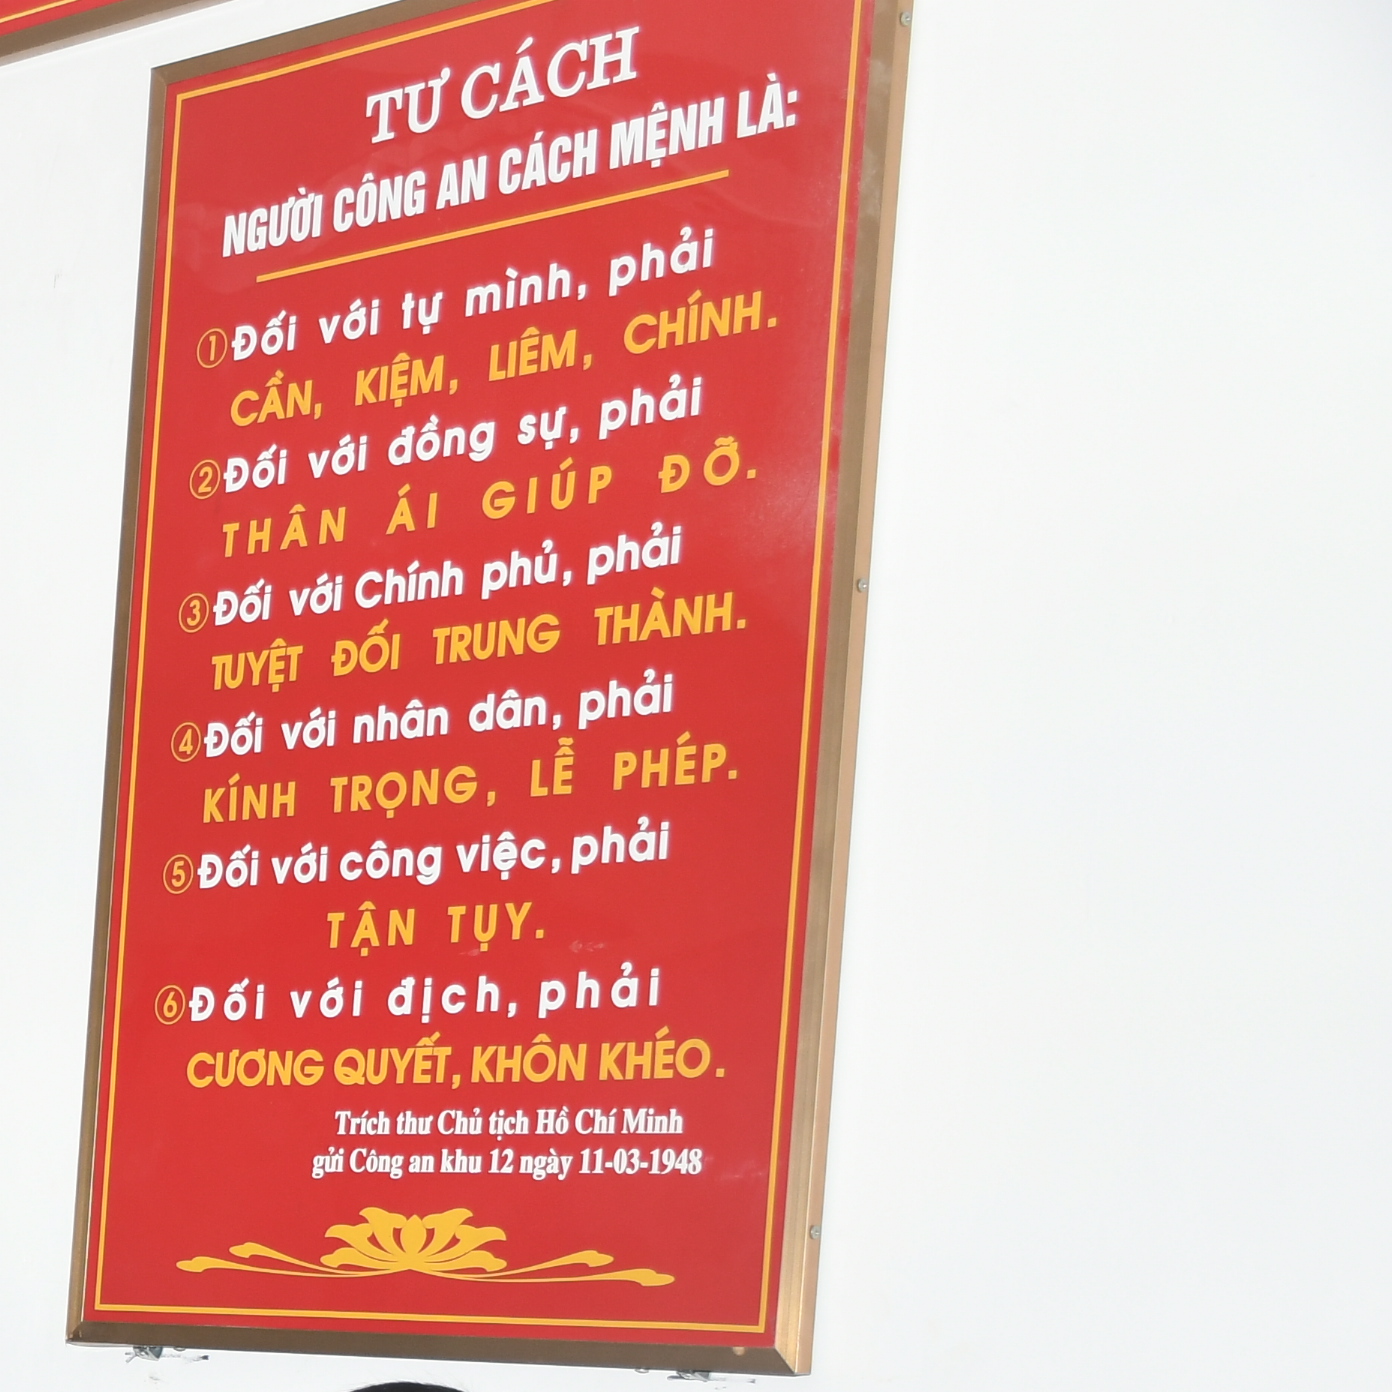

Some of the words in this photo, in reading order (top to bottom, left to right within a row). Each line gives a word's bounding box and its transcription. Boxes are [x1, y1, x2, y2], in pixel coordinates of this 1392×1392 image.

[365, 66, 452, 144] TƯ
[460, 25, 641, 120] CÁCH
[222, 186, 324, 258] NGƯỜI
[333, 169, 427, 233] CÔNG
[435, 154, 488, 210] AN
[498, 128, 598, 195] CÁCH
[609, 96, 725, 170] MỆNH
[736, 72, 798, 139] LÀ:
[231, 309, 297, 361] Đối
[318, 298, 380, 344] với
[401, 291, 444, 335] tự
[465, 262, 587, 317] mình,
[608, 225, 714, 297] phải
[230, 369, 322, 427] CẦN,
[354, 352, 458, 408] KIỆM,
[488, 326, 592, 382] LIÊM,
[623, 289, 777, 354] CHÍNH.
[222, 443, 288, 493] Đối
[308, 433, 368, 479] với
[387, 413, 496, 466] đồng
[517, 405, 580, 450] sự,
[598, 373, 703, 441] phải
[222, 503, 346, 558] THÂN
[386, 483, 438, 535] ÁI
[482, 456, 612, 519] GIÚP
[658, 435, 756, 493] ĐỠ.
[212, 578, 273, 626] Đối
[288, 572, 344, 616] với
[354, 559, 465, 609] Chính
[481, 538, 573, 600] phủ,
[586, 521, 682, 585] phải
[211, 637, 304, 693] TUYỆT
[331, 618, 401, 677] ĐỐI
[432, 613, 561, 665] TRUNG
[594, 586, 746, 646] THÀNH.
[203, 710, 264, 758] Đối
[280, 706, 337, 750] với
[353, 698, 450, 744] nhân
[468, 688, 562, 733] dân,
[578, 667, 674, 730] phải
[203, 773, 296, 823] KÍNH
[330, 765, 496, 819] TRỌNG,
[530, 737, 575, 797] LỄ
[613, 731, 738, 791] PHÉP.
[196, 843, 260, 889] Đối
[271, 841, 329, 885] với
[339, 839, 443, 886] công
[455, 830, 561, 881] việc,
[571, 815, 670, 875] phải
[326, 900, 416, 957] TẬN
[447, 901, 544, 952] TỤY.
[188, 977, 265, 1022] Đối
[289, 976, 364, 1018] với
[387, 974, 518, 1024] địch,
[538, 961, 660, 1019] phải
[186, 1048, 325, 1088] CƯƠNG
[333, 1031, 461, 1090] QUYẾT,
[471, 1033, 587, 1083] KHÔN
[599, 1026, 725, 1081] KHÉO.
[311, 1146, 345, 1179] gửi
[349, 1147, 405, 1180] Công
[408, 1154, 435, 1173] an
[439, 1148, 483, 1174] khu
[487, 1148, 515, 1174] 12
[518, 1147, 574, 1181] ngày
[578, 1147, 703, 1175] 11-03-1948
[334, 1110, 391, 1136] Trích
[396, 1110, 434, 1135] thư
[437, 1107, 483, 1135] Chủ
[488, 1109, 530, 1142] tịch
[534, 1105, 570, 1135] Hồ
[574, 1107, 618, 1135] Chí
[620, 1107, 684, 1134] Minh
